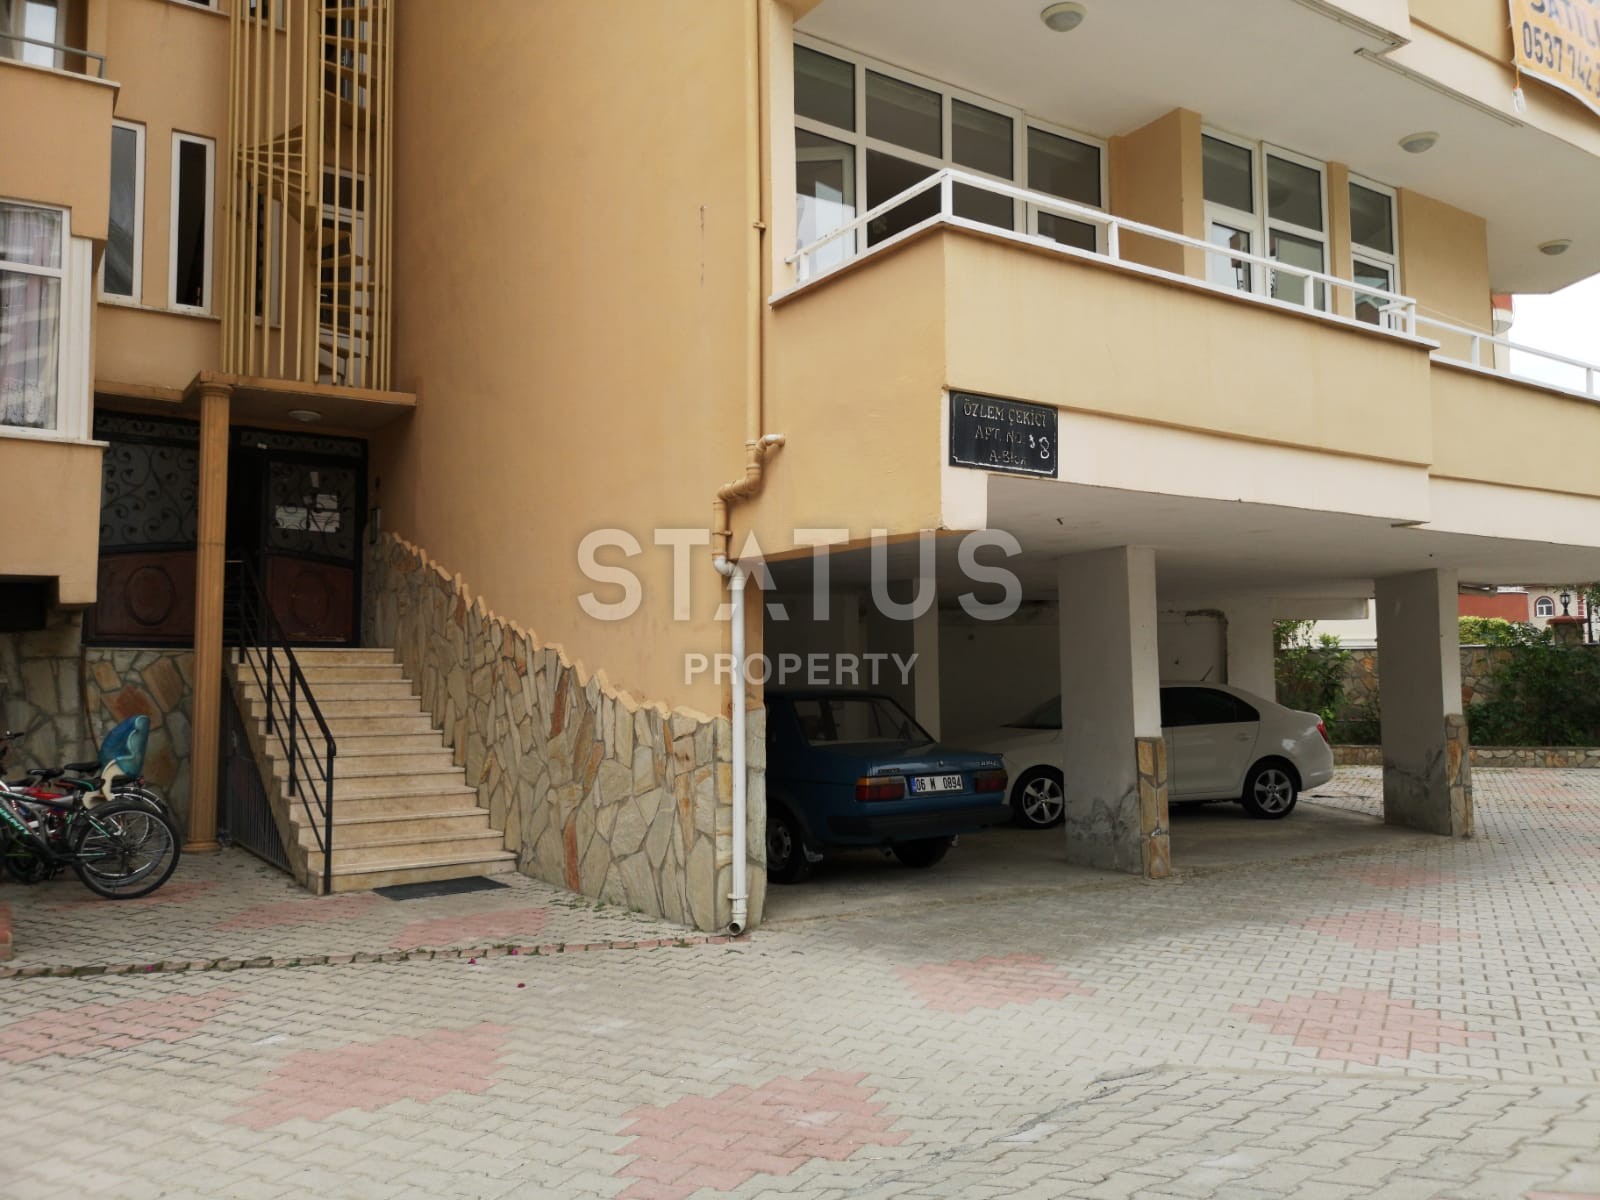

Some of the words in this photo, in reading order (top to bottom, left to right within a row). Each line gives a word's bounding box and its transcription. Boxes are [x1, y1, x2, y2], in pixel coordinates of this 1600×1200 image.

[1522, 21, 1563, 72] 0537
[963, 398, 1004, 421] ÖZLEM
[915, 778, 926, 791] 06
[942, 775, 962, 789] 0894
